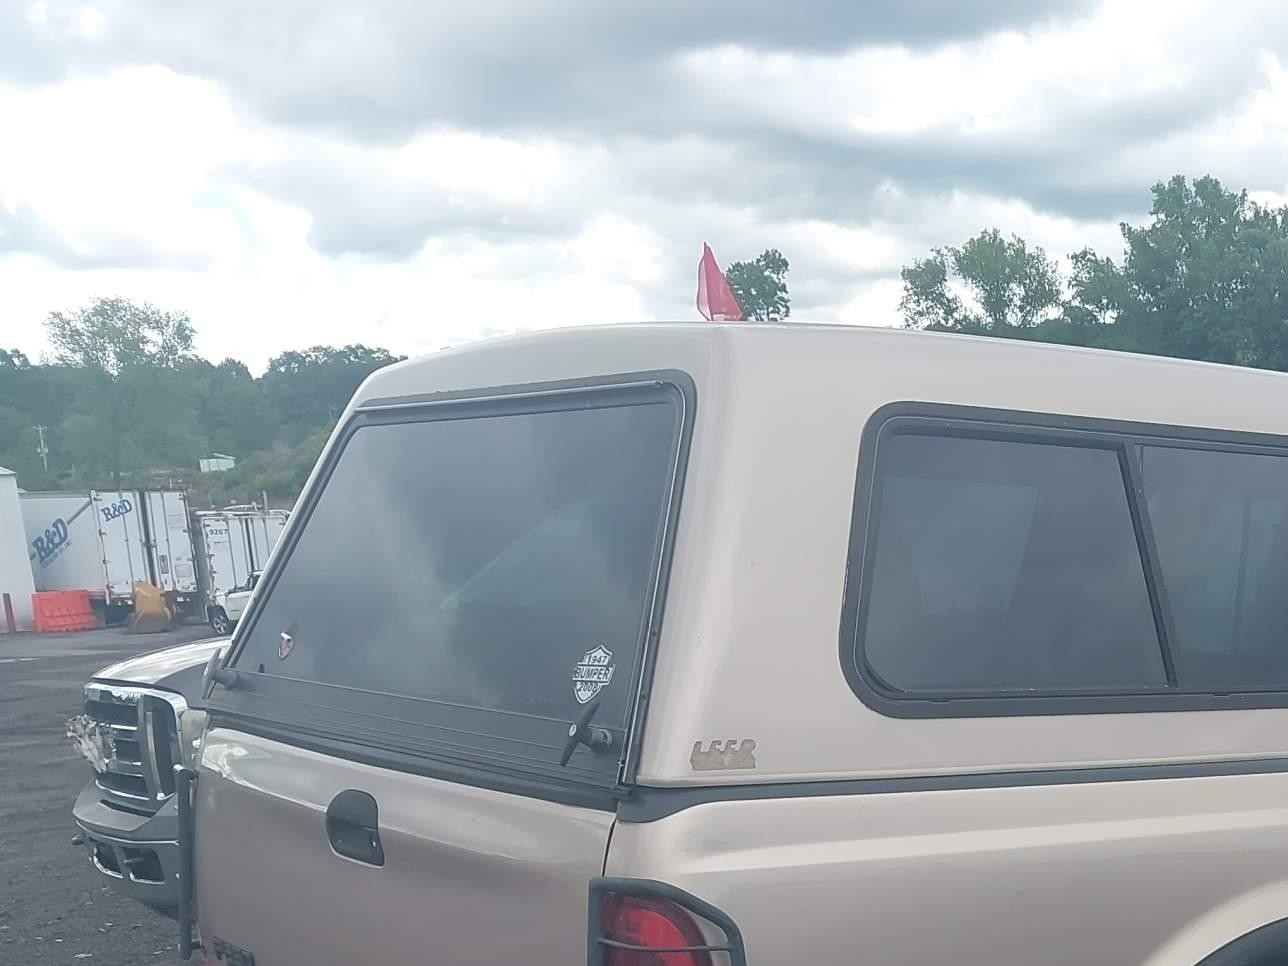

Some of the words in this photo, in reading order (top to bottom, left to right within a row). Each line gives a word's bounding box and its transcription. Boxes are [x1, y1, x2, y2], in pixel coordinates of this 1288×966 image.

[101, 499, 132, 521] R&D
[32, 518, 68, 564] R&D
[575, 666, 610, 680] BUMPER
